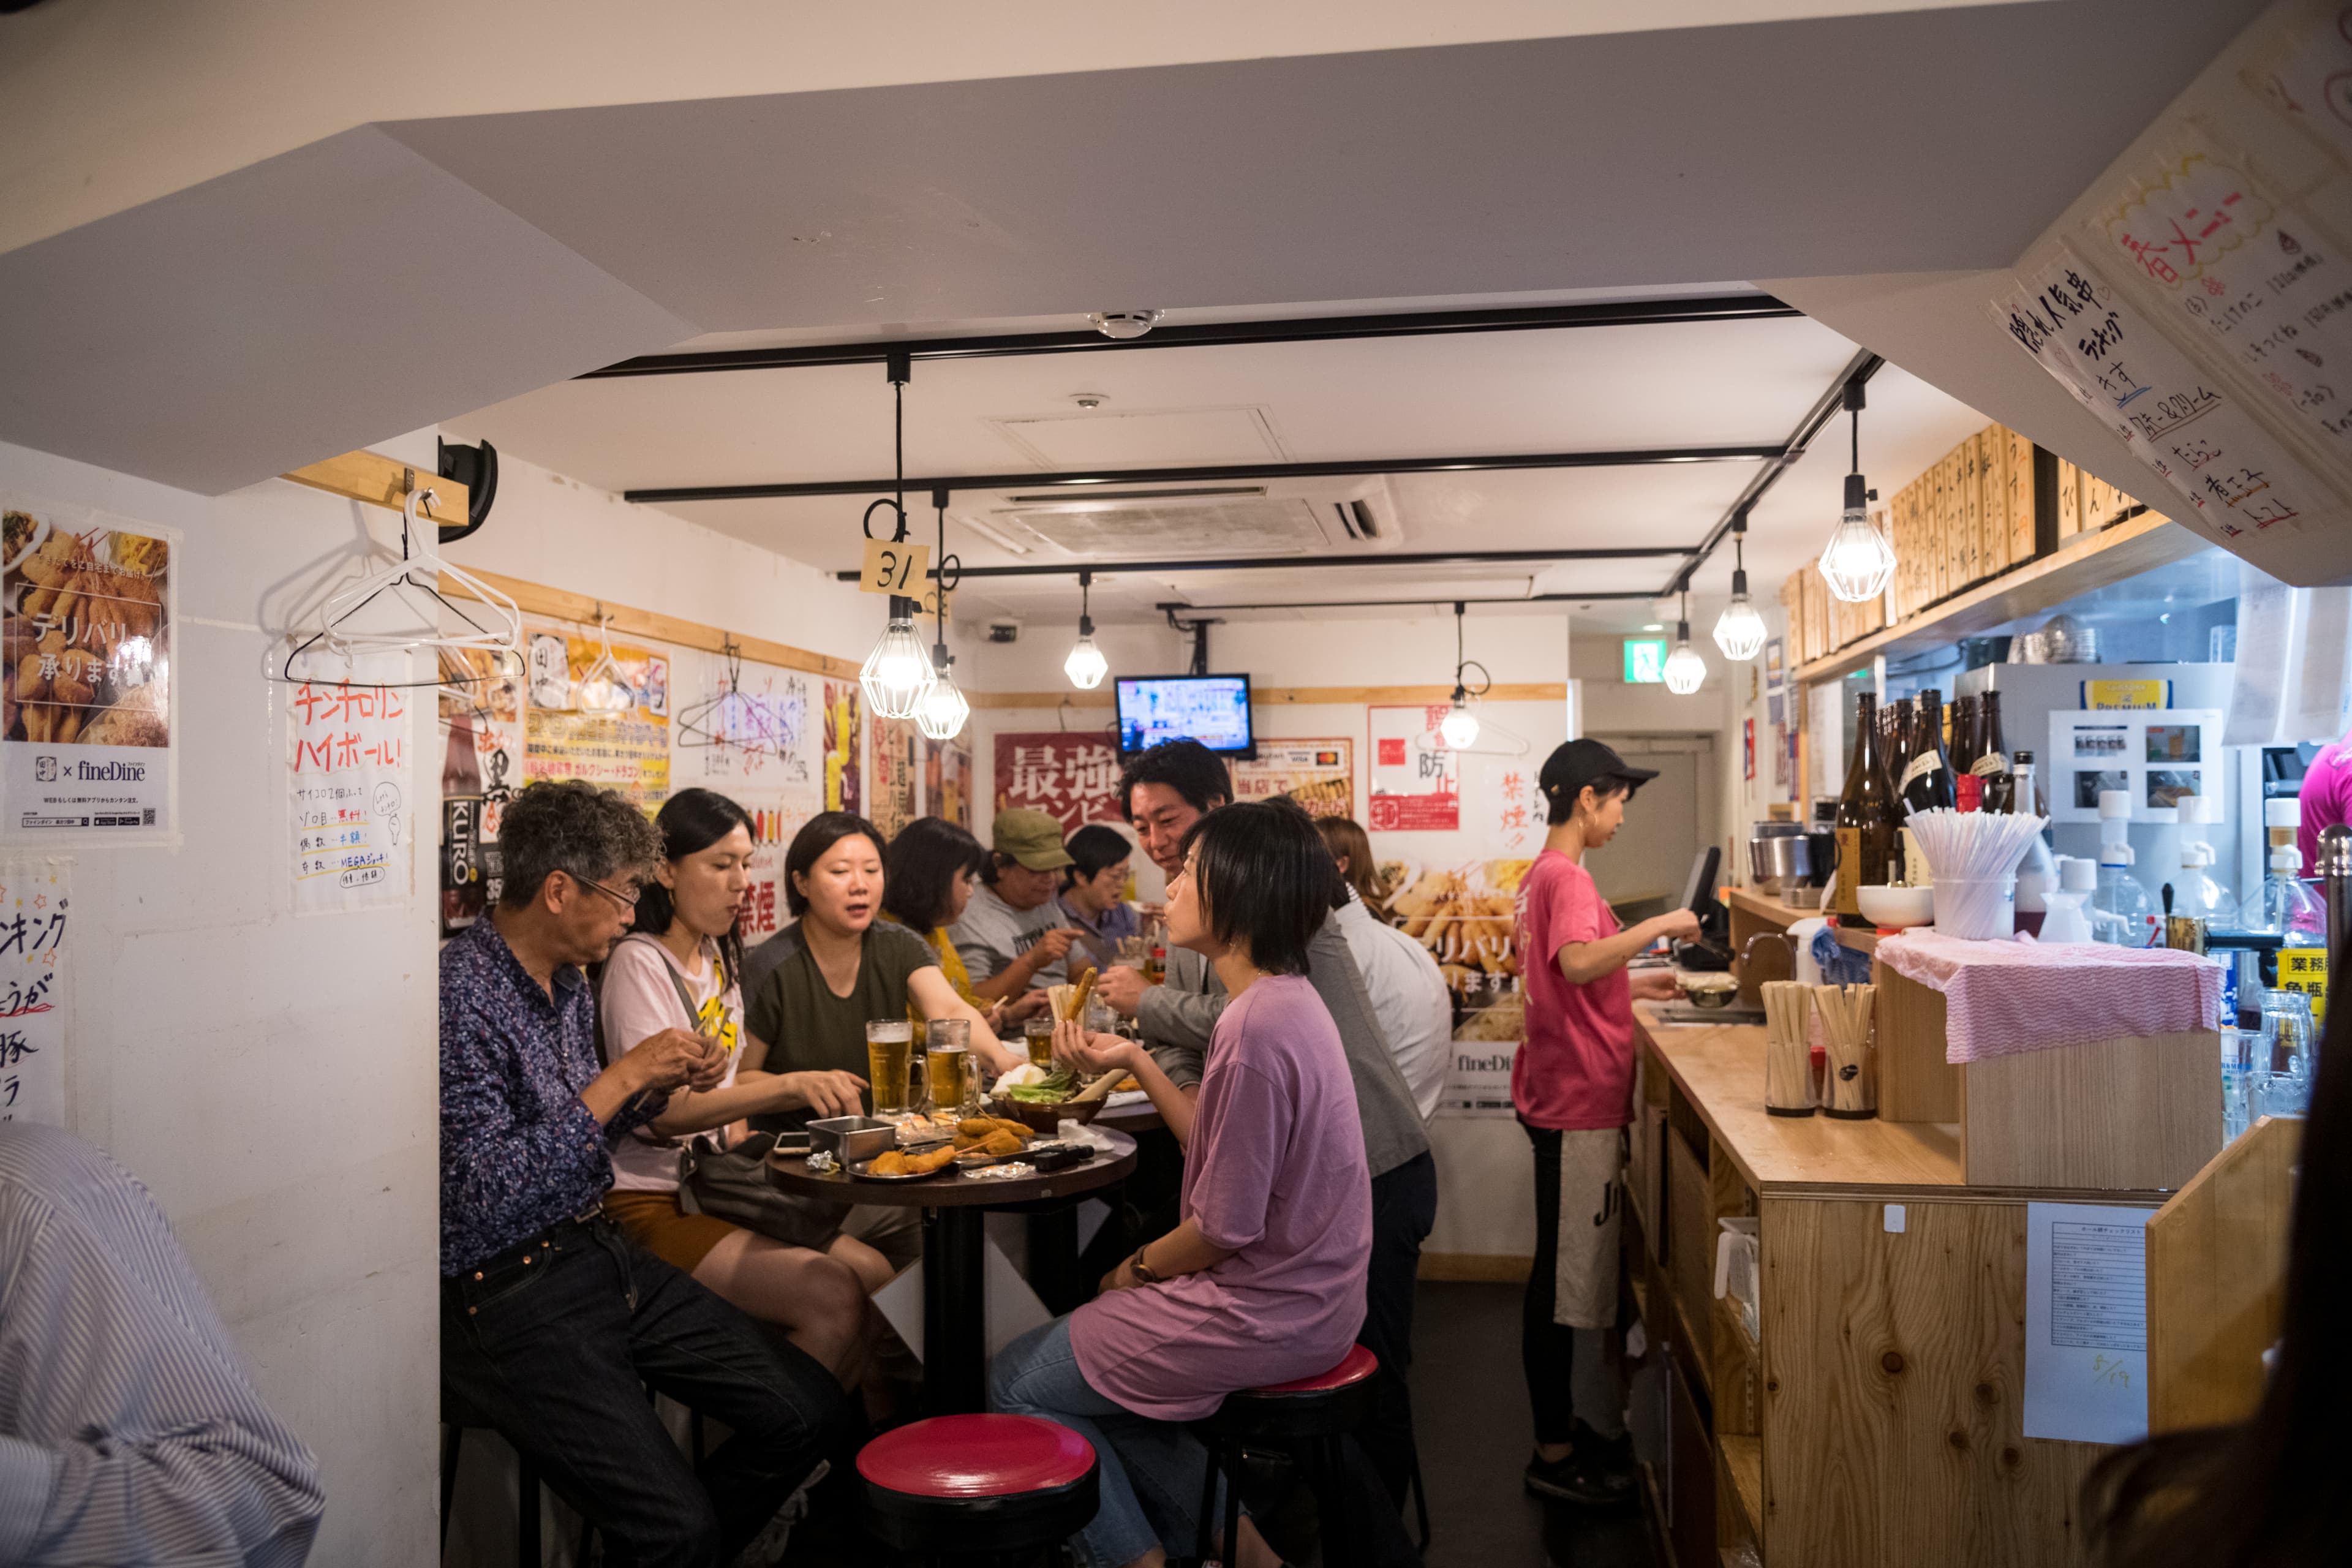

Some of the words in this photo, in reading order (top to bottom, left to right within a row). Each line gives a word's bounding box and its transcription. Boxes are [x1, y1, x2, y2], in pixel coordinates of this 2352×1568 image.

[877, 550, 913, 590] 31
[32, 613, 147, 649] デリバリ
[295, 677, 403, 726] チンチロリン
[78, 760, 146, 782] fineDine
[1008, 744, 1123, 800] 最強
[452, 801, 470, 885] KURO
[1436, 935, 1510, 963] リバリ
[2291, 957, 2328, 972] 業務
